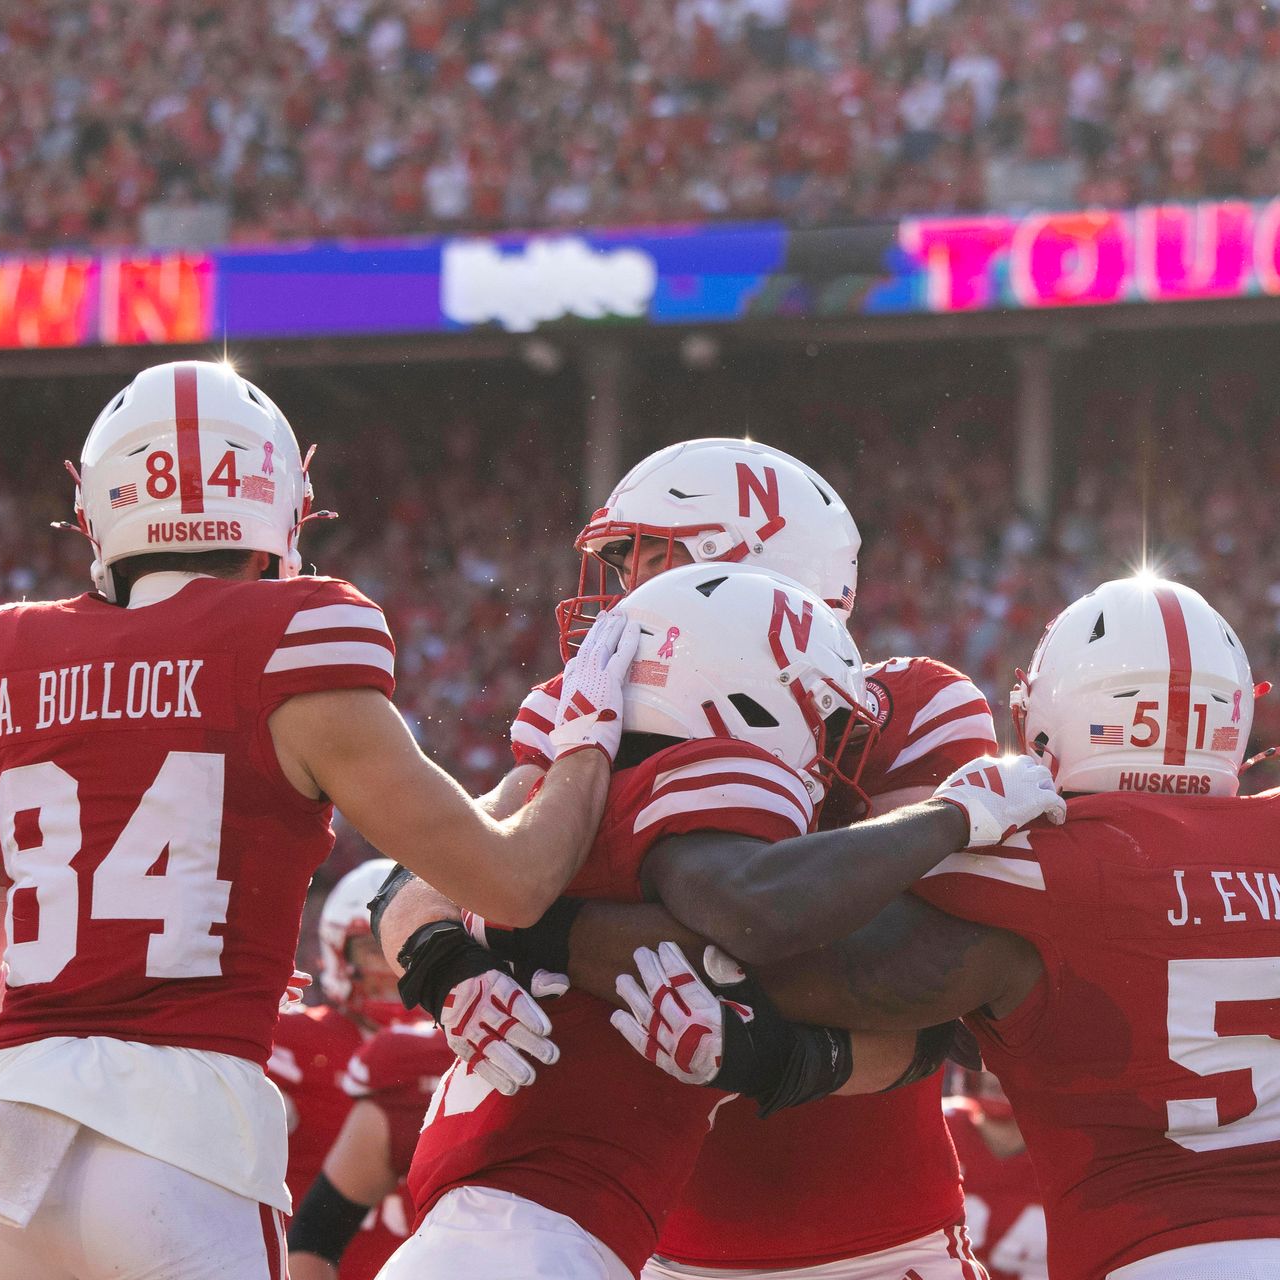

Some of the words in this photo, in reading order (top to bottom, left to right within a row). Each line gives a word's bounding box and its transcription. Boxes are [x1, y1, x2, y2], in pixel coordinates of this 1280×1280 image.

[735, 462, 780, 522] N
[148, 521, 242, 543] HUSKERS
[768, 588, 814, 652] N
[35, 659, 205, 730] BULLOCK
[1119, 771, 1211, 795] HUSKERS
[1167, 870, 1201, 927] J.
